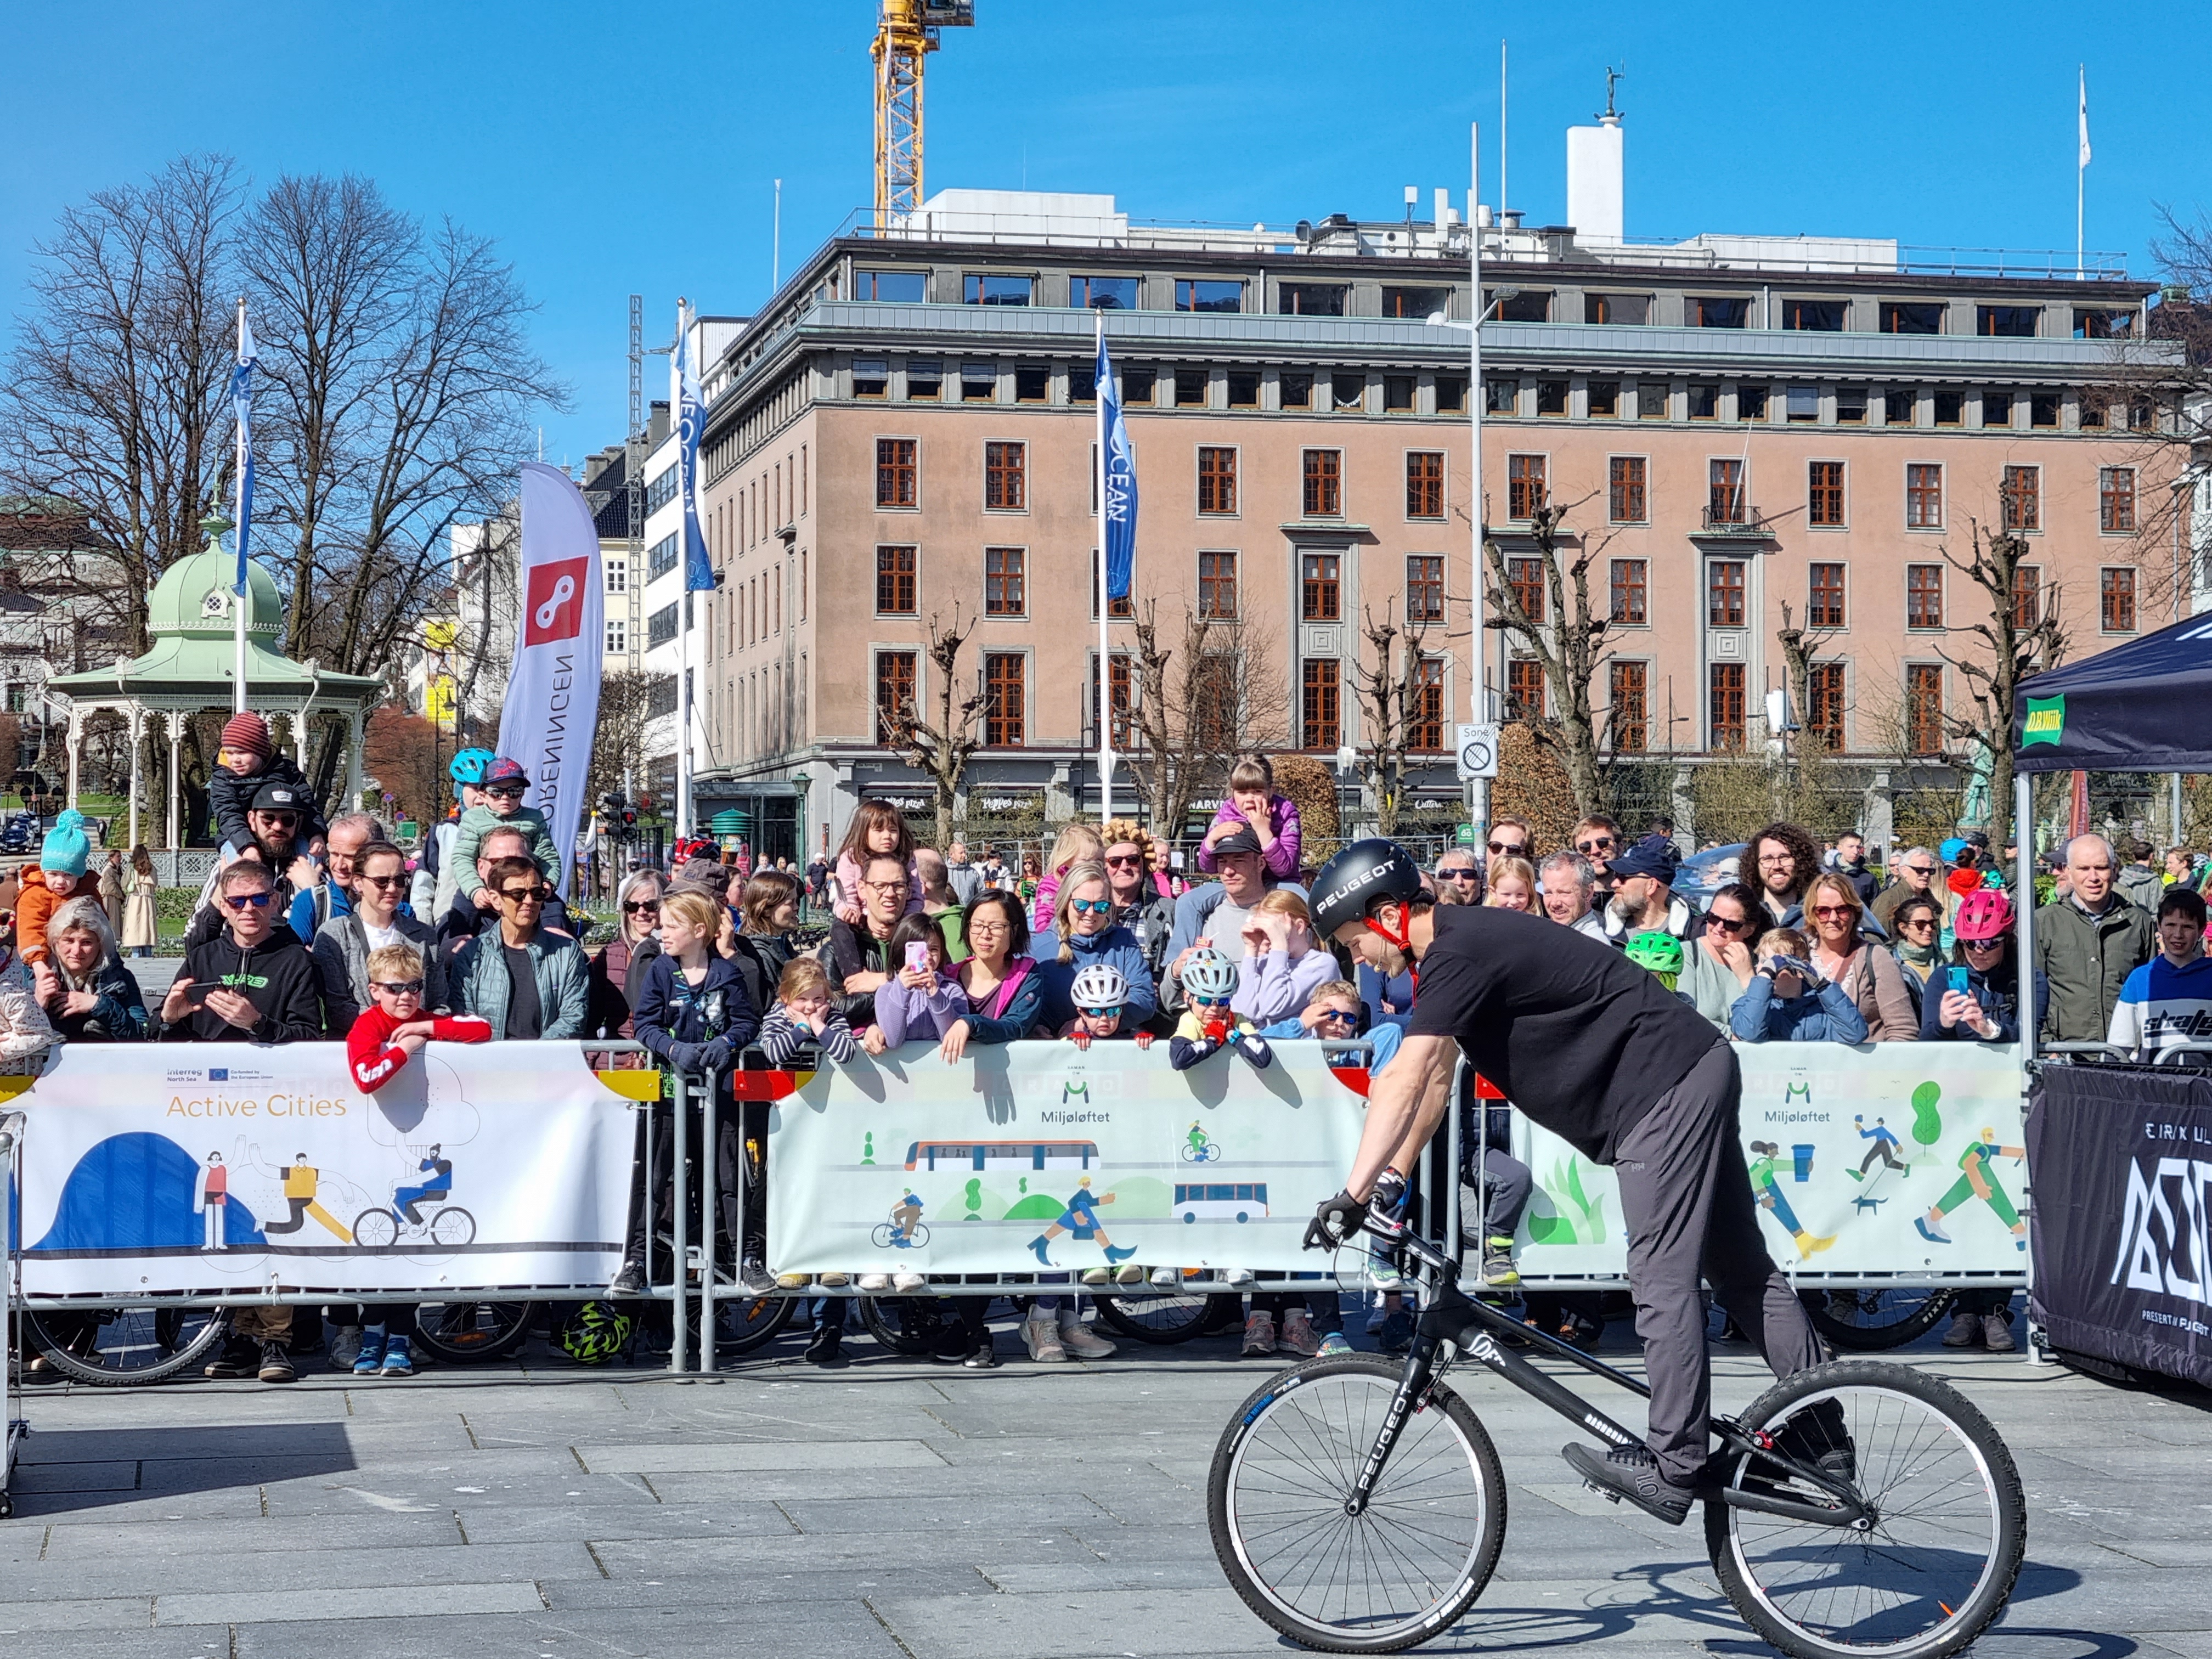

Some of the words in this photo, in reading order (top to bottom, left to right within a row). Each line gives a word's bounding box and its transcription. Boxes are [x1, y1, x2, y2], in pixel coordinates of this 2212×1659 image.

[1464, 727, 1488, 737] Sone
[1317, 860, 1395, 915] PEUGEOT
[166, 1094, 257, 1118] Active
[267, 1094, 347, 1117] Cities
[1041, 1111, 1110, 1125] Miljøløftet
[1765, 1111, 1830, 1125] Miljøløftet
[1358, 1381, 1412, 1491] PEUGEOT
